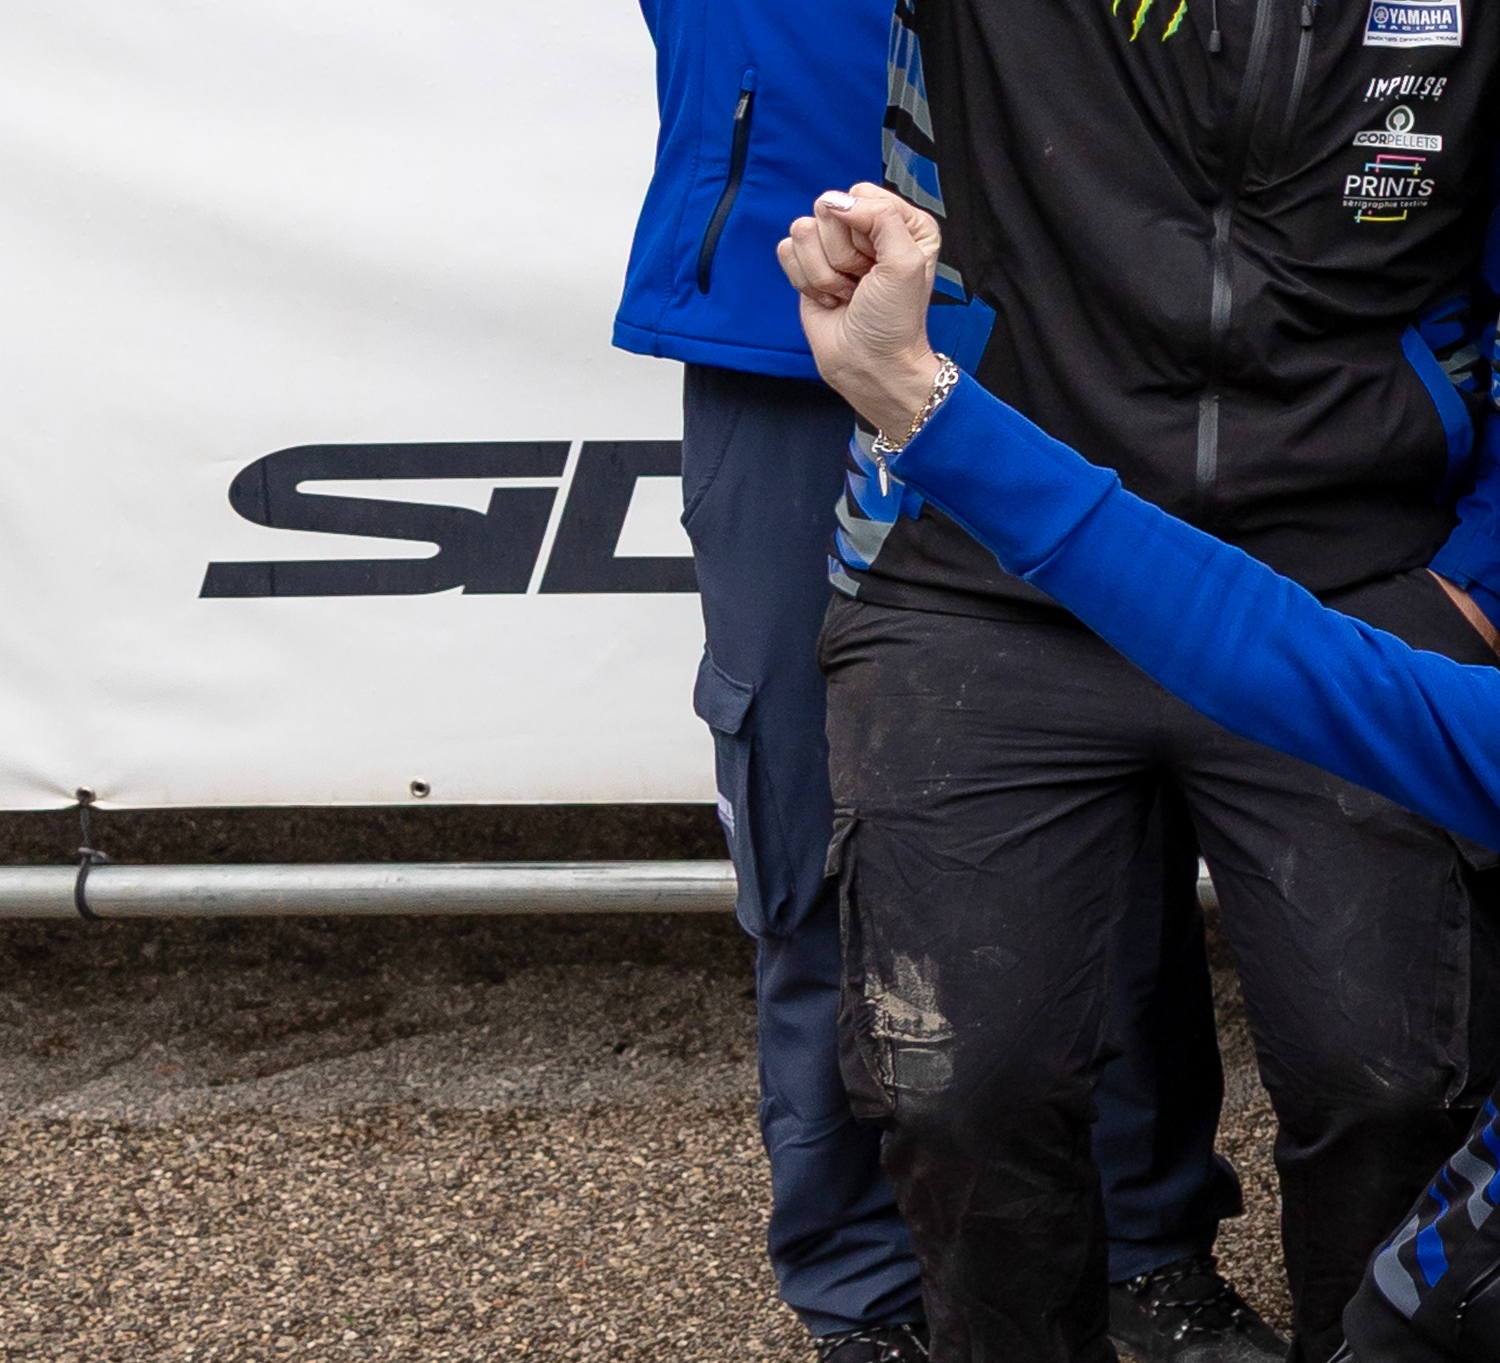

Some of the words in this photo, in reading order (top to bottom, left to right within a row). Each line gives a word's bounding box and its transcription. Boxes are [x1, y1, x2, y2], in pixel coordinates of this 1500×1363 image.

[1389, 8, 1453, 26] YAMAHA
[1366, 75, 1448, 98] IMPULSE
[1357, 133, 1438, 149] CORPELLETS
[1343, 174, 1436, 197] PRINTS
